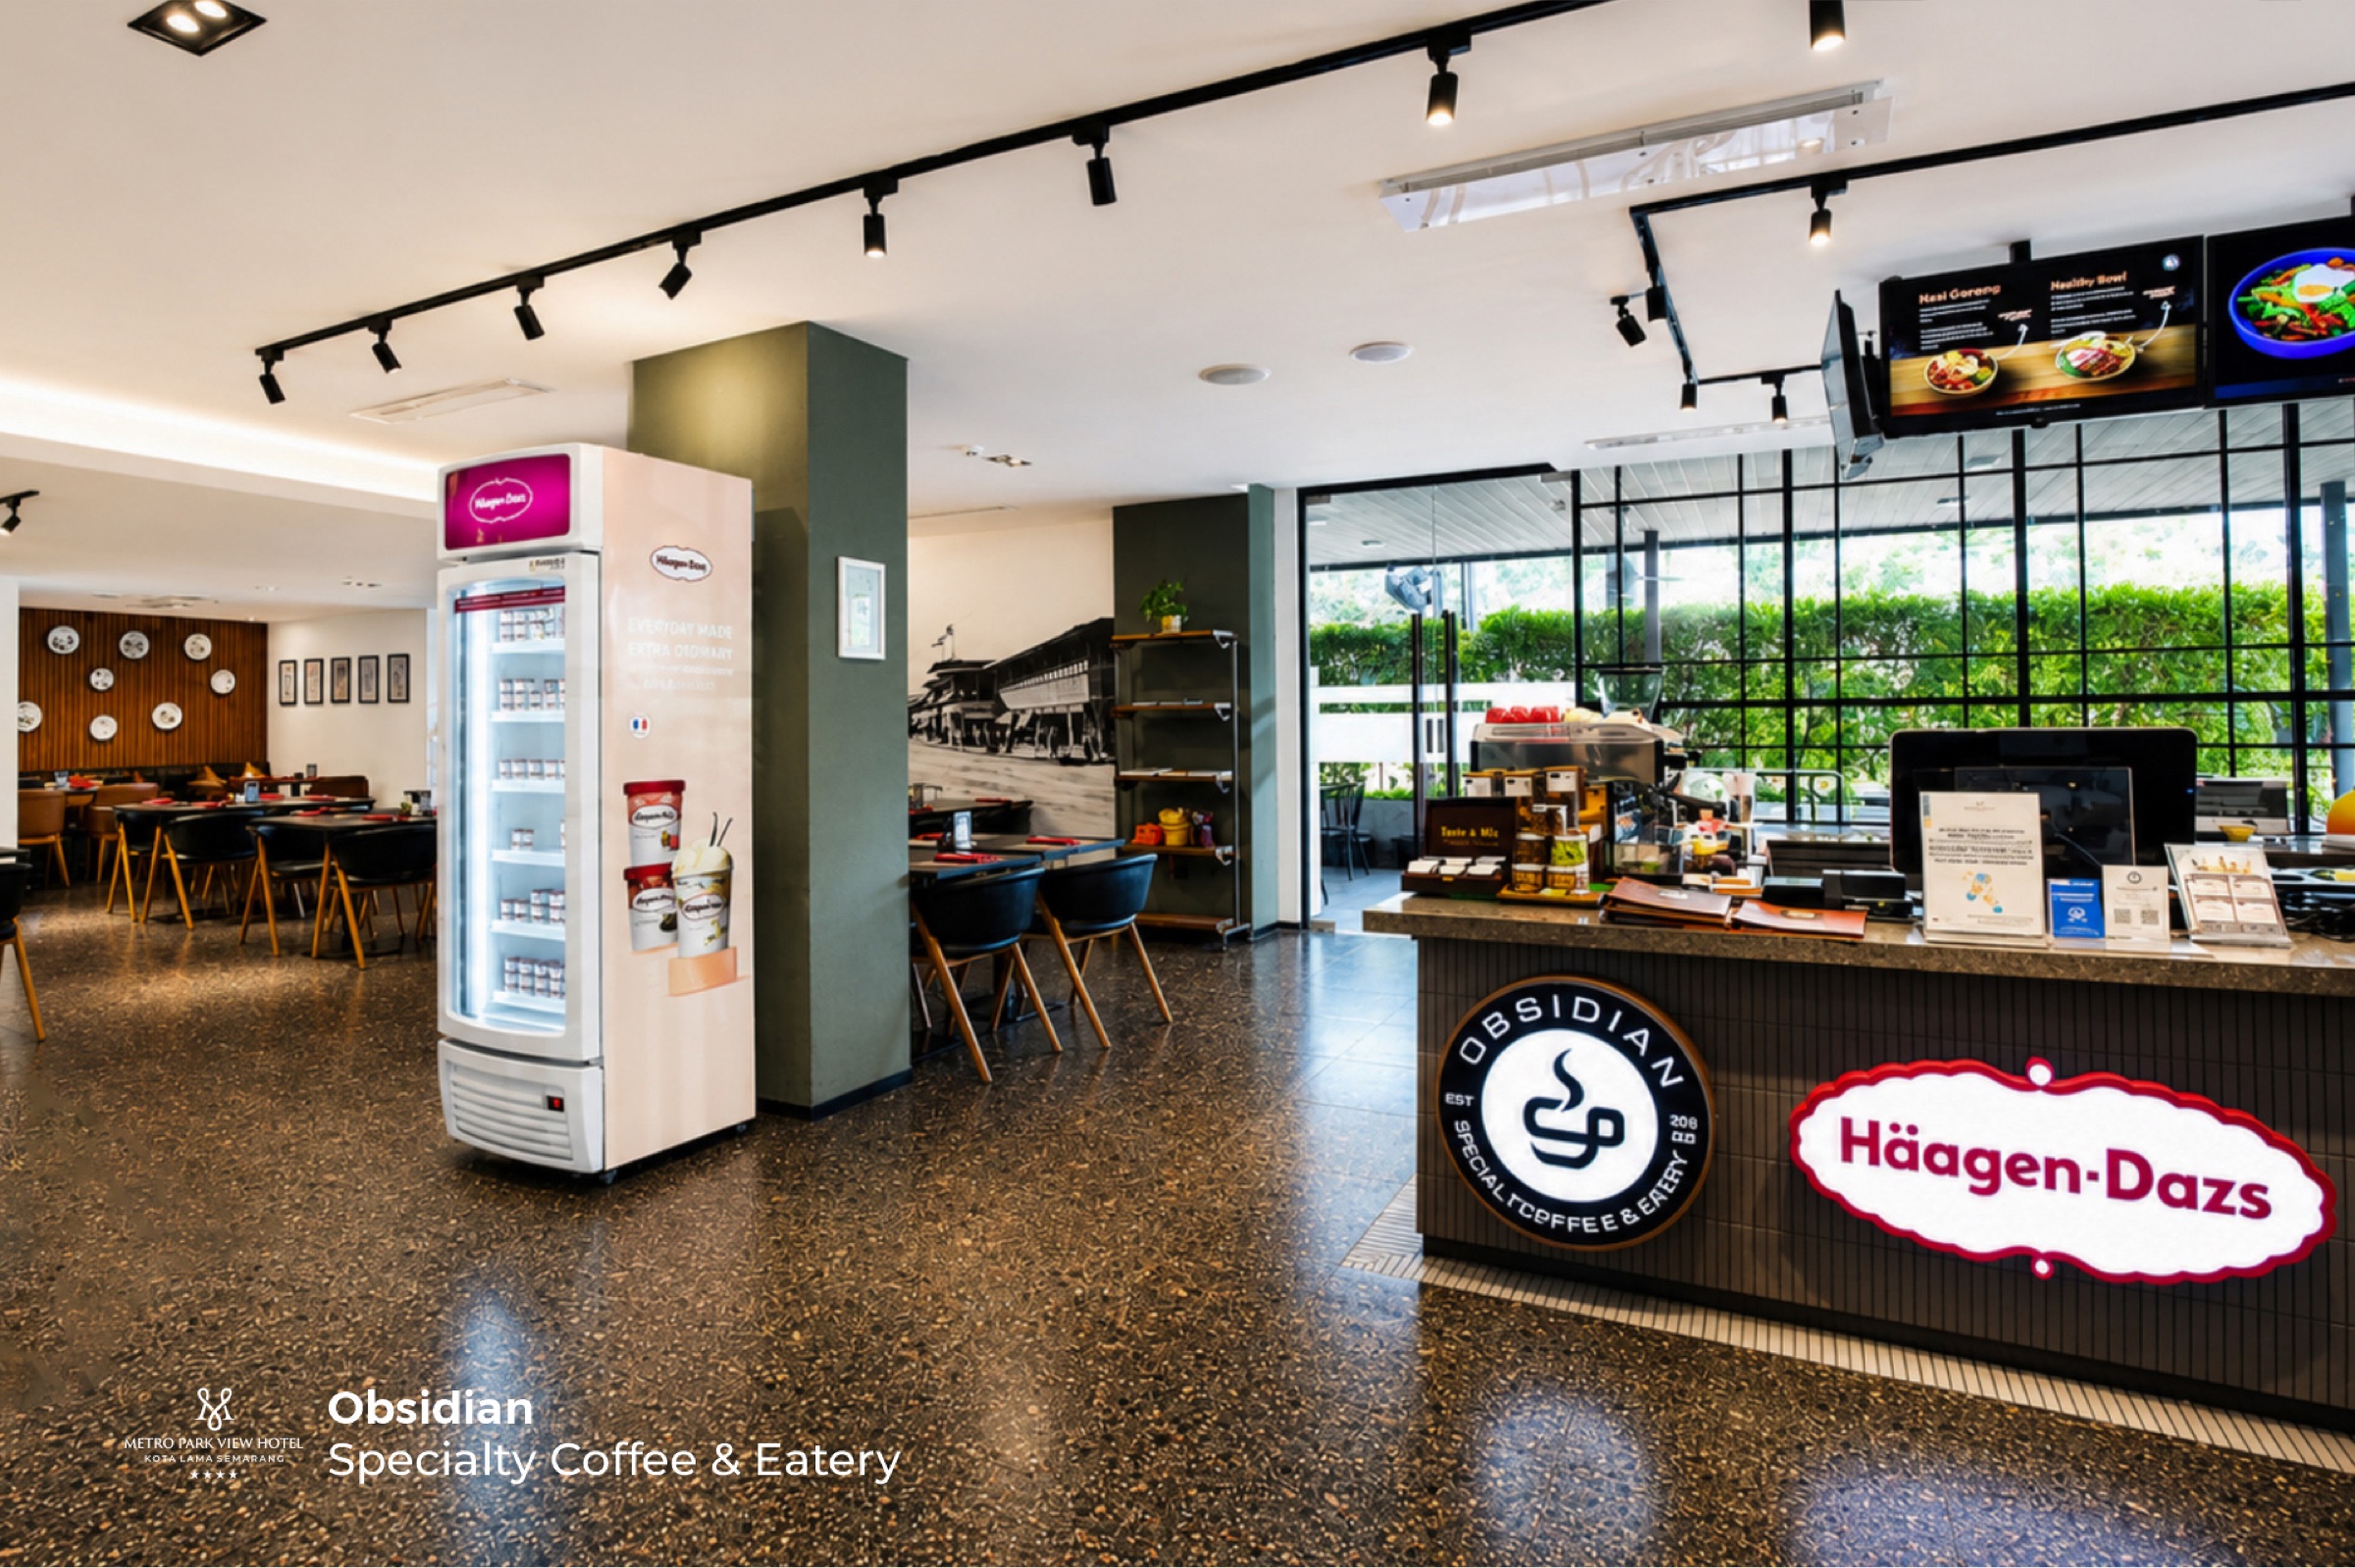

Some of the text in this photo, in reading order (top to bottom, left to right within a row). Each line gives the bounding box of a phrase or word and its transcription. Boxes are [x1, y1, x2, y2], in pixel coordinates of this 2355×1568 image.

[1459, 994, 1685, 1088] OBSIDIAN
[1445, 1093, 1474, 1107] EST
[1840, 1116, 2274, 1221] Häagen-Dazs
[1620, 1208, 1640, 1225] &
